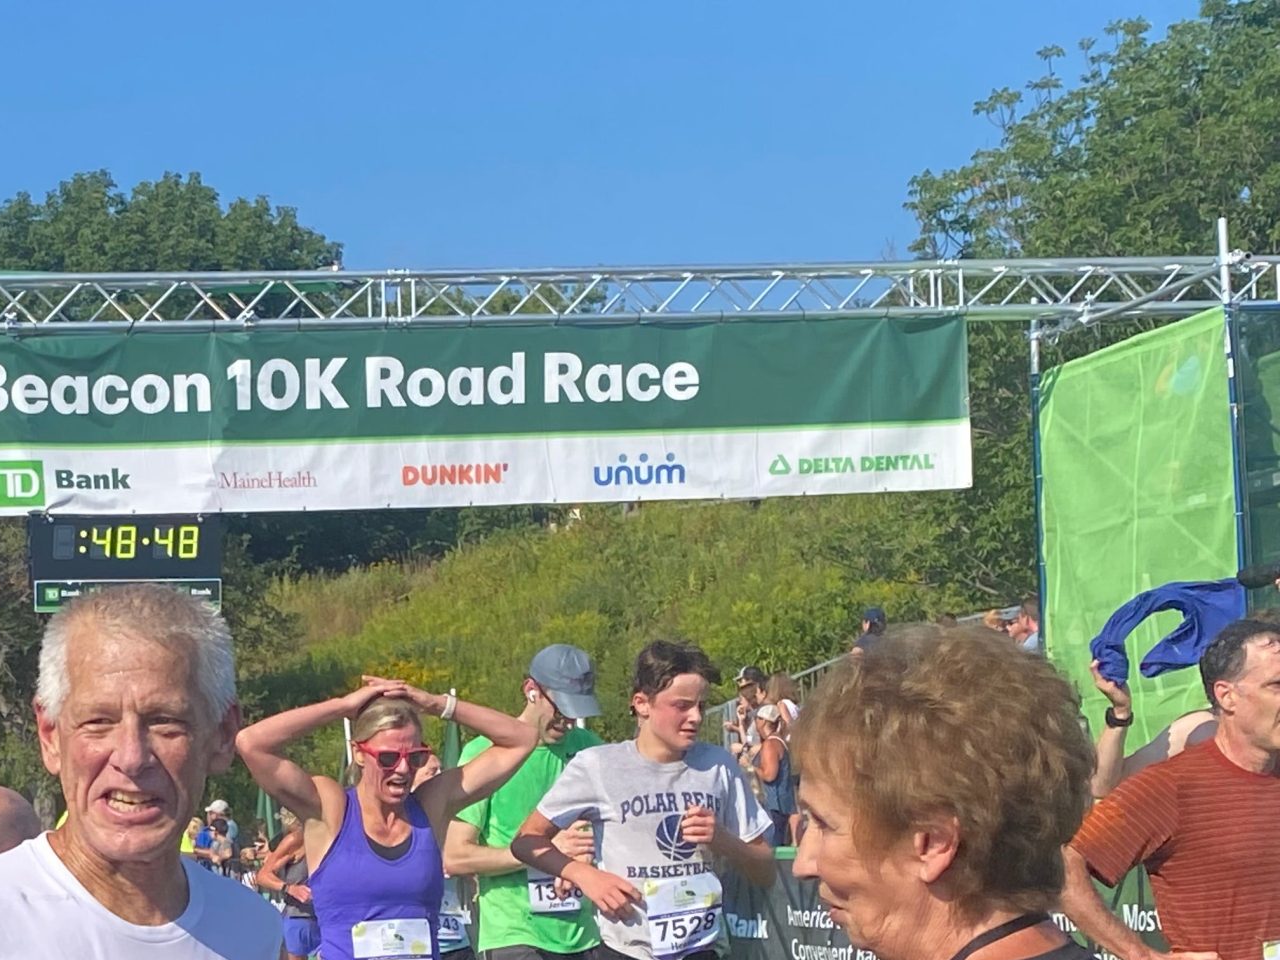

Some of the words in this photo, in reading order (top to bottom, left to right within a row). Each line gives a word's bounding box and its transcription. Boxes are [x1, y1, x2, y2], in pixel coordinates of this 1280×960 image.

[226, 357, 350, 412] 10K
[364, 351, 526, 408] Road
[543, 351, 701, 404] Race
[798, 458, 856, 475] DELTA
[860, 454, 934, 473] DENTAL
[54, 467, 132, 490] Bank
[219, 471, 318, 489] MaineHealth
[620, 793, 679, 824] POLAR
[655, 912, 716, 942] 7528
[786, 904, 841, 930] America
